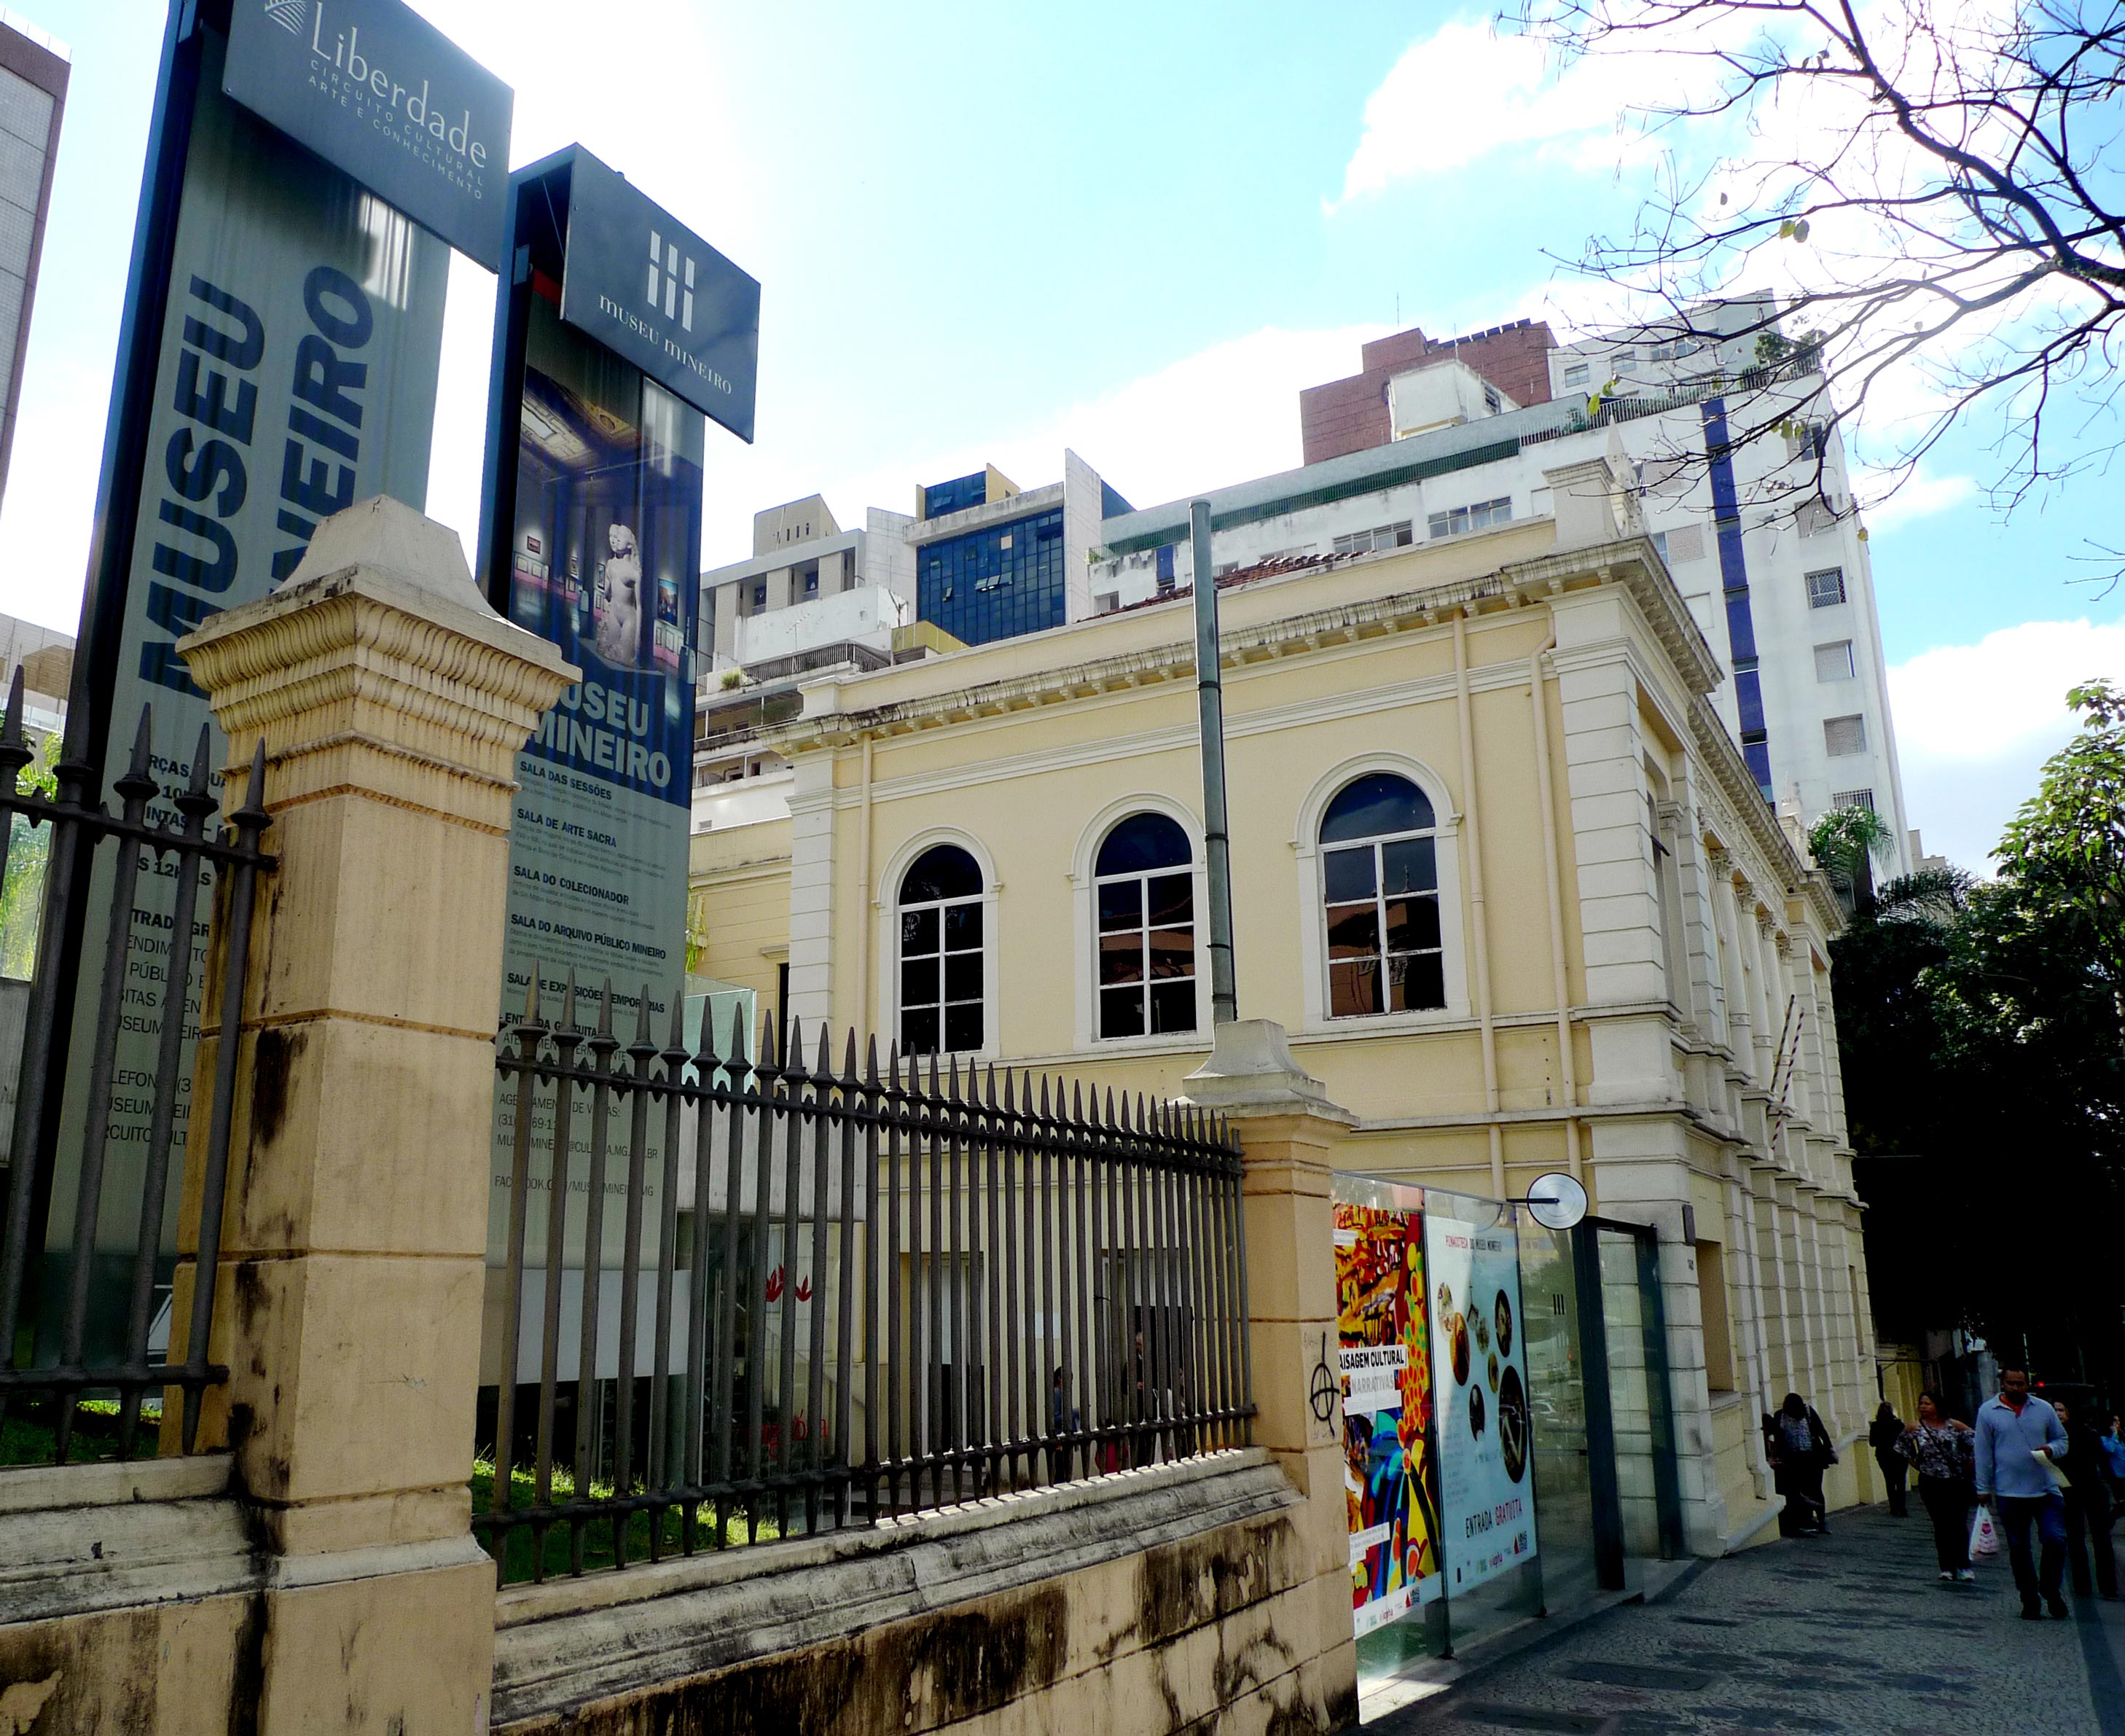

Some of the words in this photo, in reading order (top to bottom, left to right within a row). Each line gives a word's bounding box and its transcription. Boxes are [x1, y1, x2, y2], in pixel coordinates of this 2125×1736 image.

[311, 1, 488, 169] Liberdade
[308, 75, 349, 107] ARTE
[357, 107, 364, 119] E
[372, 119, 482, 200] CONHECIMENTO
[310, 60, 394, 122] CIRCUITO
[404, 124, 484, 187] CULTURAL
[268, 265, 374, 594] NEIRO
[138, 273, 265, 701] MUSEU
[558, 681, 649, 738] USEU
[526, 710, 672, 789] MINEIRO
[520, 760, 546, 779] SALA
[548, 770, 568, 786] DAS
[569, 777, 613, 801] SESSÕES
[517, 808, 544, 825] SALA
[545, 816, 559, 830] DE
[561, 819, 585, 837] ARTE
[587, 829, 617, 849] SACRA
[513, 865, 541, 883] SALA
[542, 872, 557, 886] DO
[559, 877, 630, 906] COLECIONADOR
[510, 913, 536, 930] SALA
[538, 919, 552, 933] DO
[552, 923, 593, 943] ARQUIVO
[594, 933, 631, 952] PÚBLICO
[632, 942, 667, 961] MINEIRO
[506, 972, 531, 987] SALA
[549, 980, 604, 1001] EXPSIÇÕES
[611, 993, 665, 1014] EMPORRIAS
[1339, 1352, 1370, 1370] AISAGEM
[1370, 1349, 1404, 1367] CULTURAL
[1351, 1374, 1394, 1395] NARRATIVAS
[1465, 1509, 1493, 1538] ENTRADA
[1495, 1496, 1522, 1526] GRATUITA
